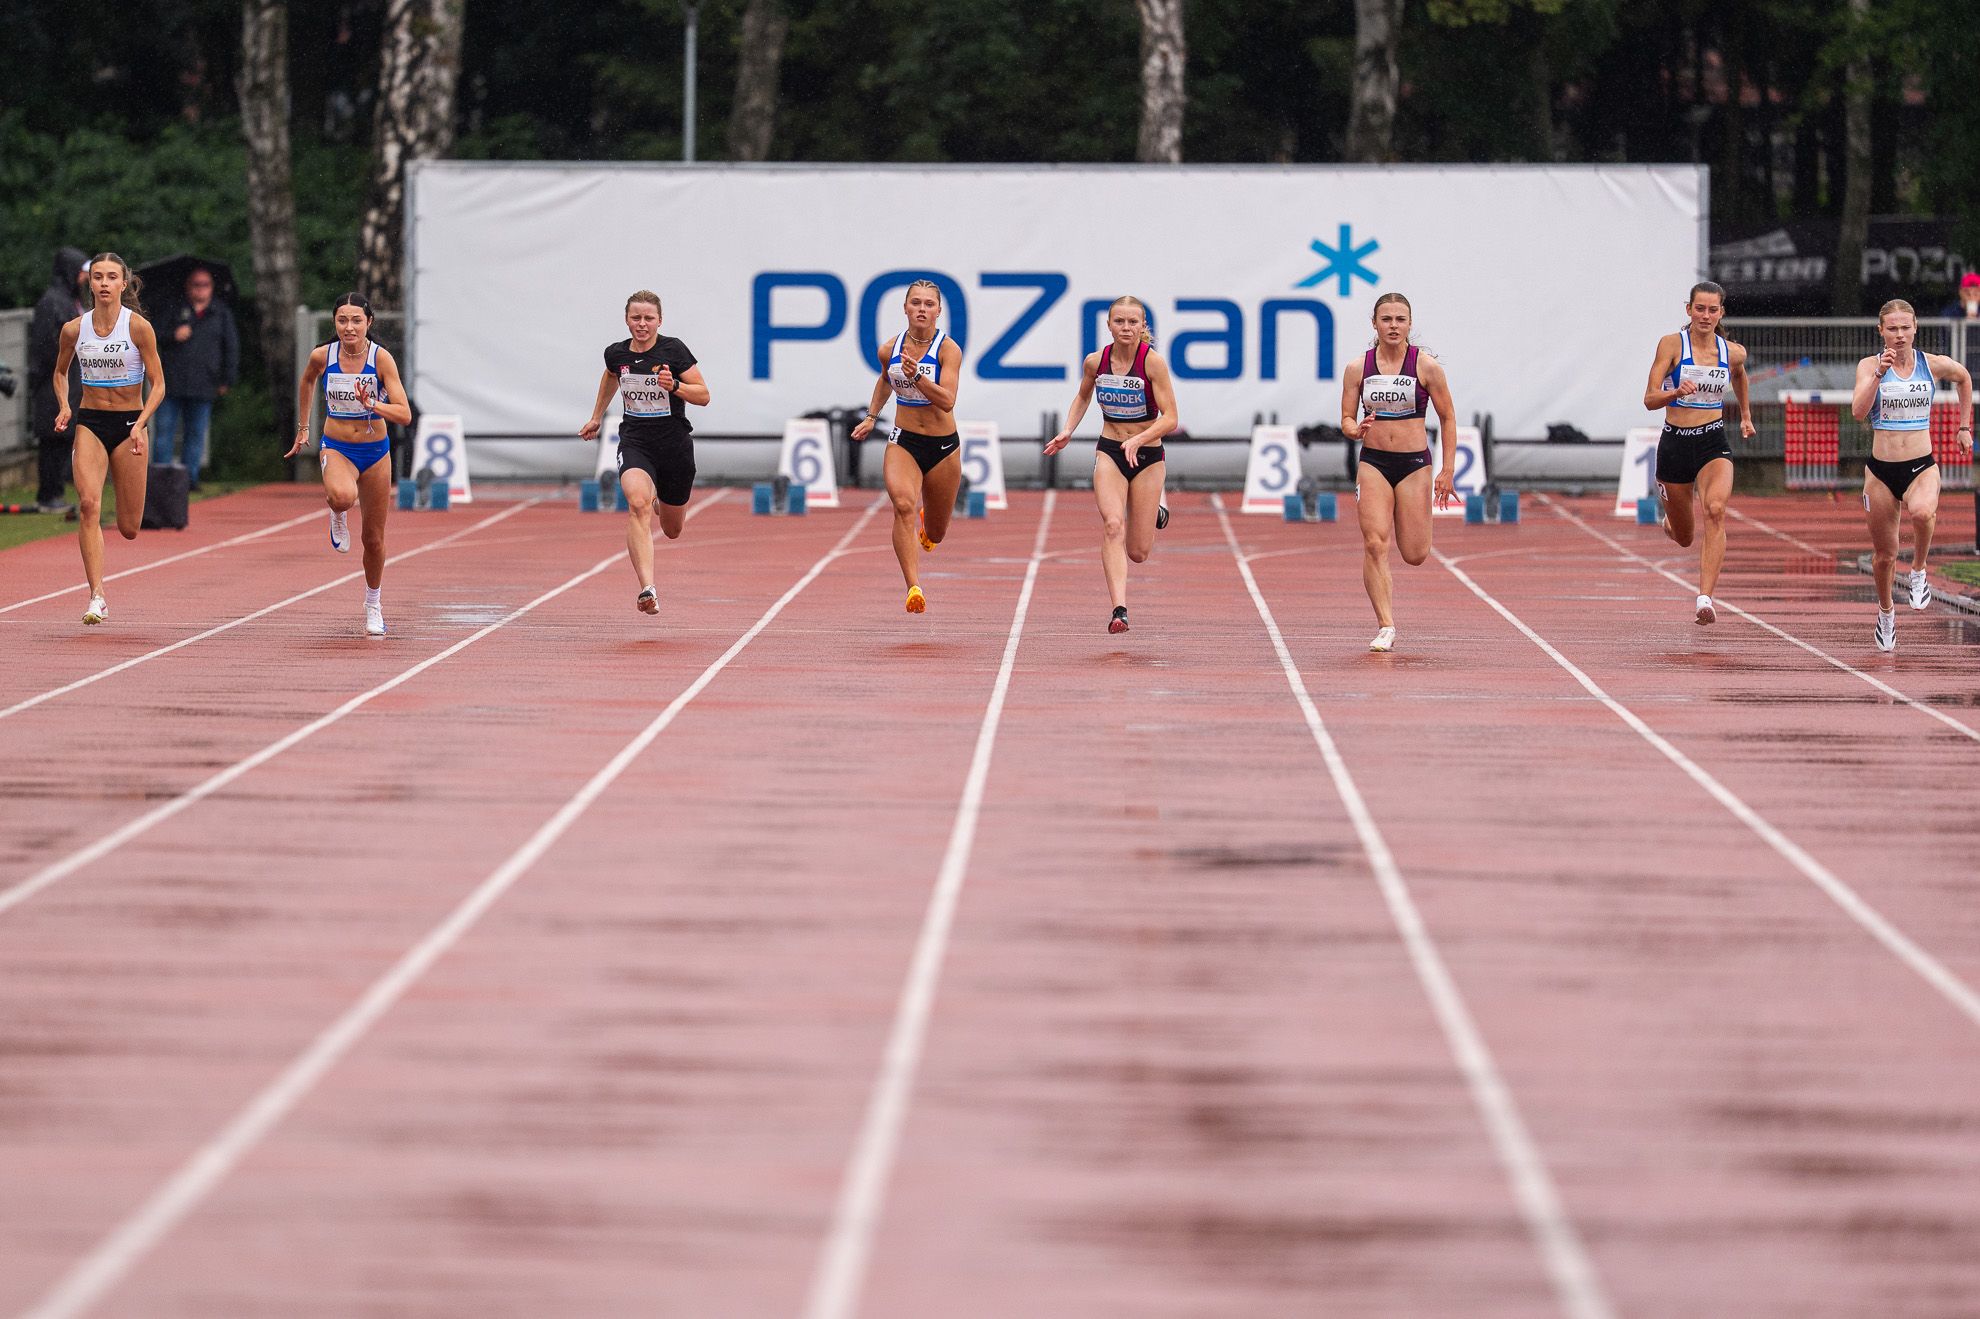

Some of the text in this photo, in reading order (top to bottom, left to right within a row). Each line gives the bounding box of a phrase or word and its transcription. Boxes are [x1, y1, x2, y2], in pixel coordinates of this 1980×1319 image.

[103, 344, 122, 353] 657
[80, 358, 125, 369] GRABOWSKA
[919, 365, 931, 375] 85
[1708, 369, 1726, 379] 475
[644, 377, 660, 387] 68
[1122, 379, 1141, 389] 586
[1392, 378, 1412, 387] 460
[1909, 384, 1928, 393] 241
[327, 390, 377, 402] NIEZGA
[623, 391, 666, 401] KOZYRA
[1097, 391, 1143, 404] GONDEK
[1370, 391, 1407, 403] GRĘDA
[1882, 397, 1930, 411] PIĄTKOWSKA
[1675, 426, 1704, 437] NIKE
[1705, 420, 1724, 433] PRO
[425, 433, 454, 483] 8
[791, 438, 822, 486] 6
[963, 439, 990, 486] 5
[1259, 443, 1290, 492] 3
[1453, 445, 1475, 494] 2
[1634, 446, 1657, 495] 1
